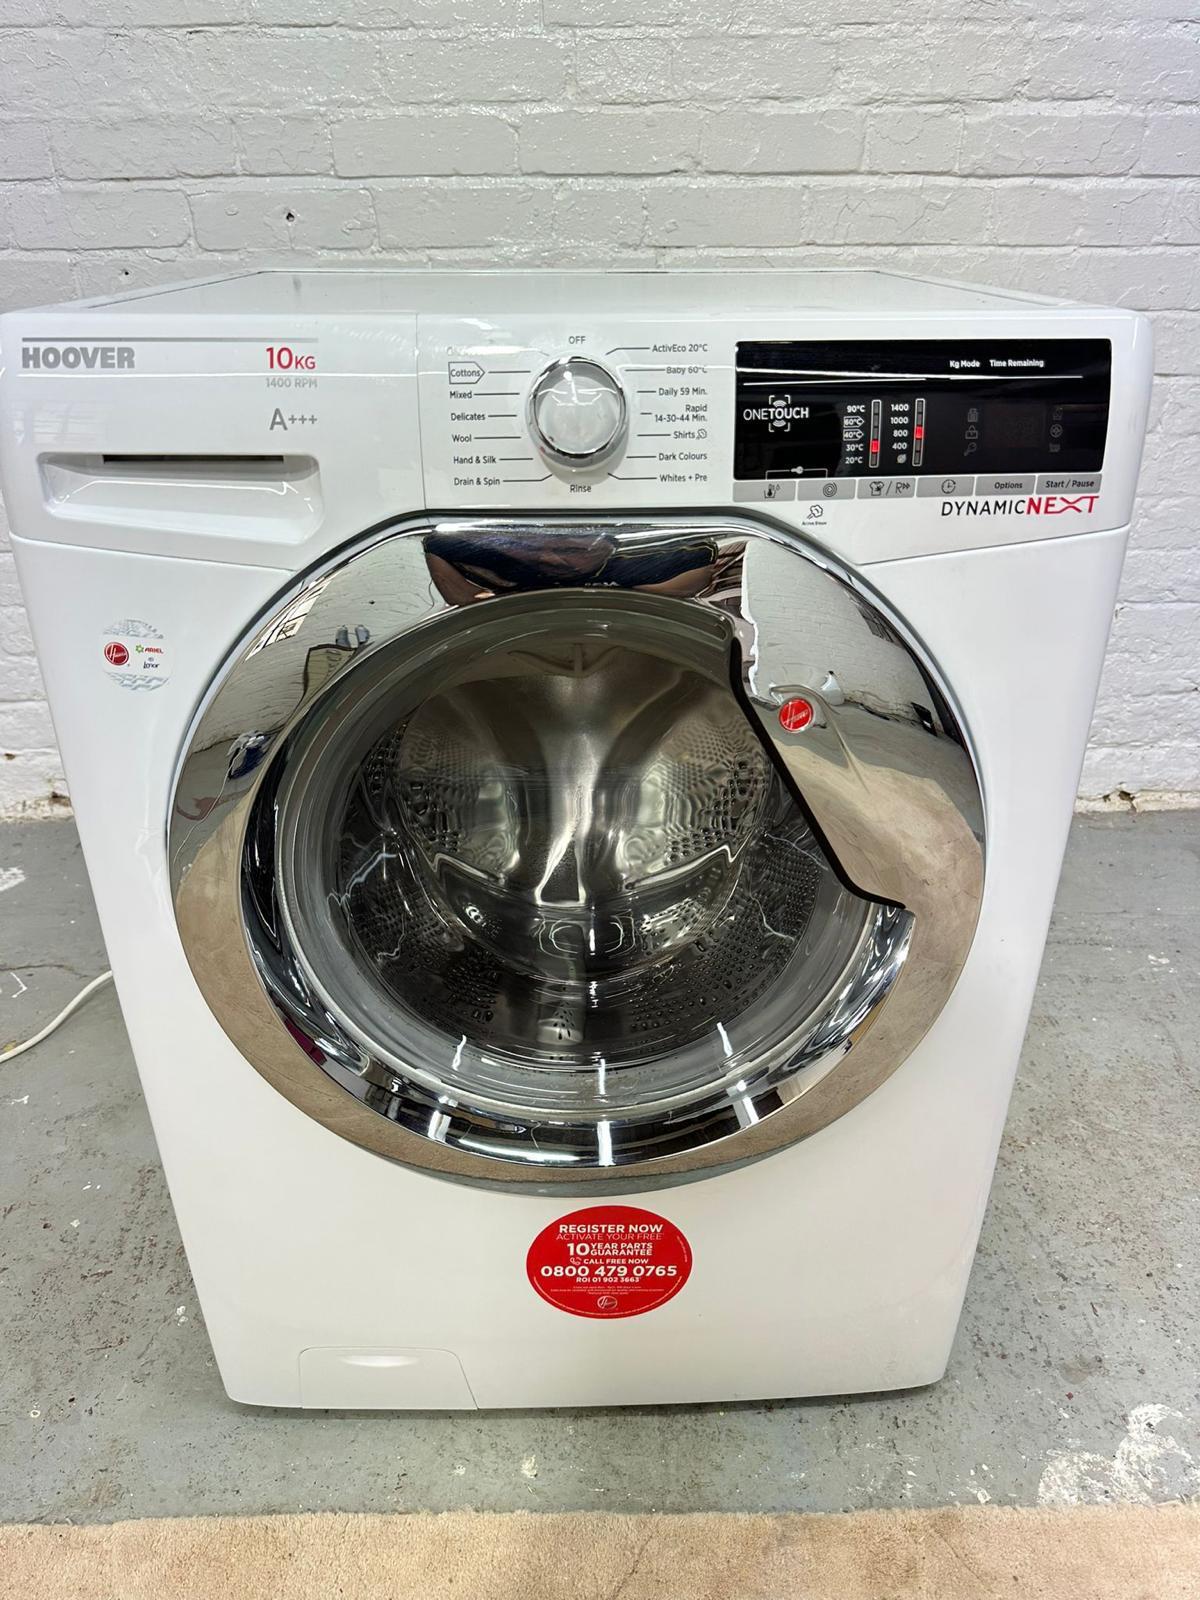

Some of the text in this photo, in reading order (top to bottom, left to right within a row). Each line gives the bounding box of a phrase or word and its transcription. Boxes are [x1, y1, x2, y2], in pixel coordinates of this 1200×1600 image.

[569, 335, 586, 345] OFF
[652, 344, 708, 353] ActivEco 20°C
[22, 347, 136, 370] HOOVER
[265, 347, 316, 370] 10KG
[950, 360, 981, 369] Kg Mode
[989, 359, 1044, 369] Time Remaining
[450, 368, 481, 378] Cottons
[666, 366, 687, 376] Baby
[265, 377, 318, 389] 1400 RPM
[449, 390, 473, 399] Mixed
[658, 387, 708, 397] Daily 59 Min.
[685, 404, 708, 413] Rapid
[846, 405, 866, 413] 90°C
[890, 403, 910, 412] 1400
[450, 412, 486, 421] Delicates
[743, 406, 810, 421] ONETOUCH
[269, 407, 318, 431] A+++
[655, 414, 708, 423] 14-30-44 Min.
[890, 416, 909, 425] 1000
[673, 431, 696, 440] Shirts
[893, 429, 908, 437] 800
[451, 434, 473, 443] Wool
[846, 443, 865, 452] 30°C
[892, 442, 908, 450] 400
[453, 455, 497, 464] Hand & Silk
[658, 452, 708, 461] Dark Colours
[845, 456, 864, 464] 20°C
[659, 473, 686, 482] Whites
[694, 473, 708, 482] Pre
[453, 477, 500, 488] Drain & Spin
[994, 481, 1023, 490] Options
[1045, 480, 1065, 489] Start
[1072, 479, 1095, 488] Pause
[569, 485, 592, 493] Rinse
[559, 1224, 663, 1233] REGISTER NOW
[567, 1243, 590, 1256] 10
[620, 1242, 653, 1250] PARTS
[540, 1265, 677, 1277] 0800 479 0765
